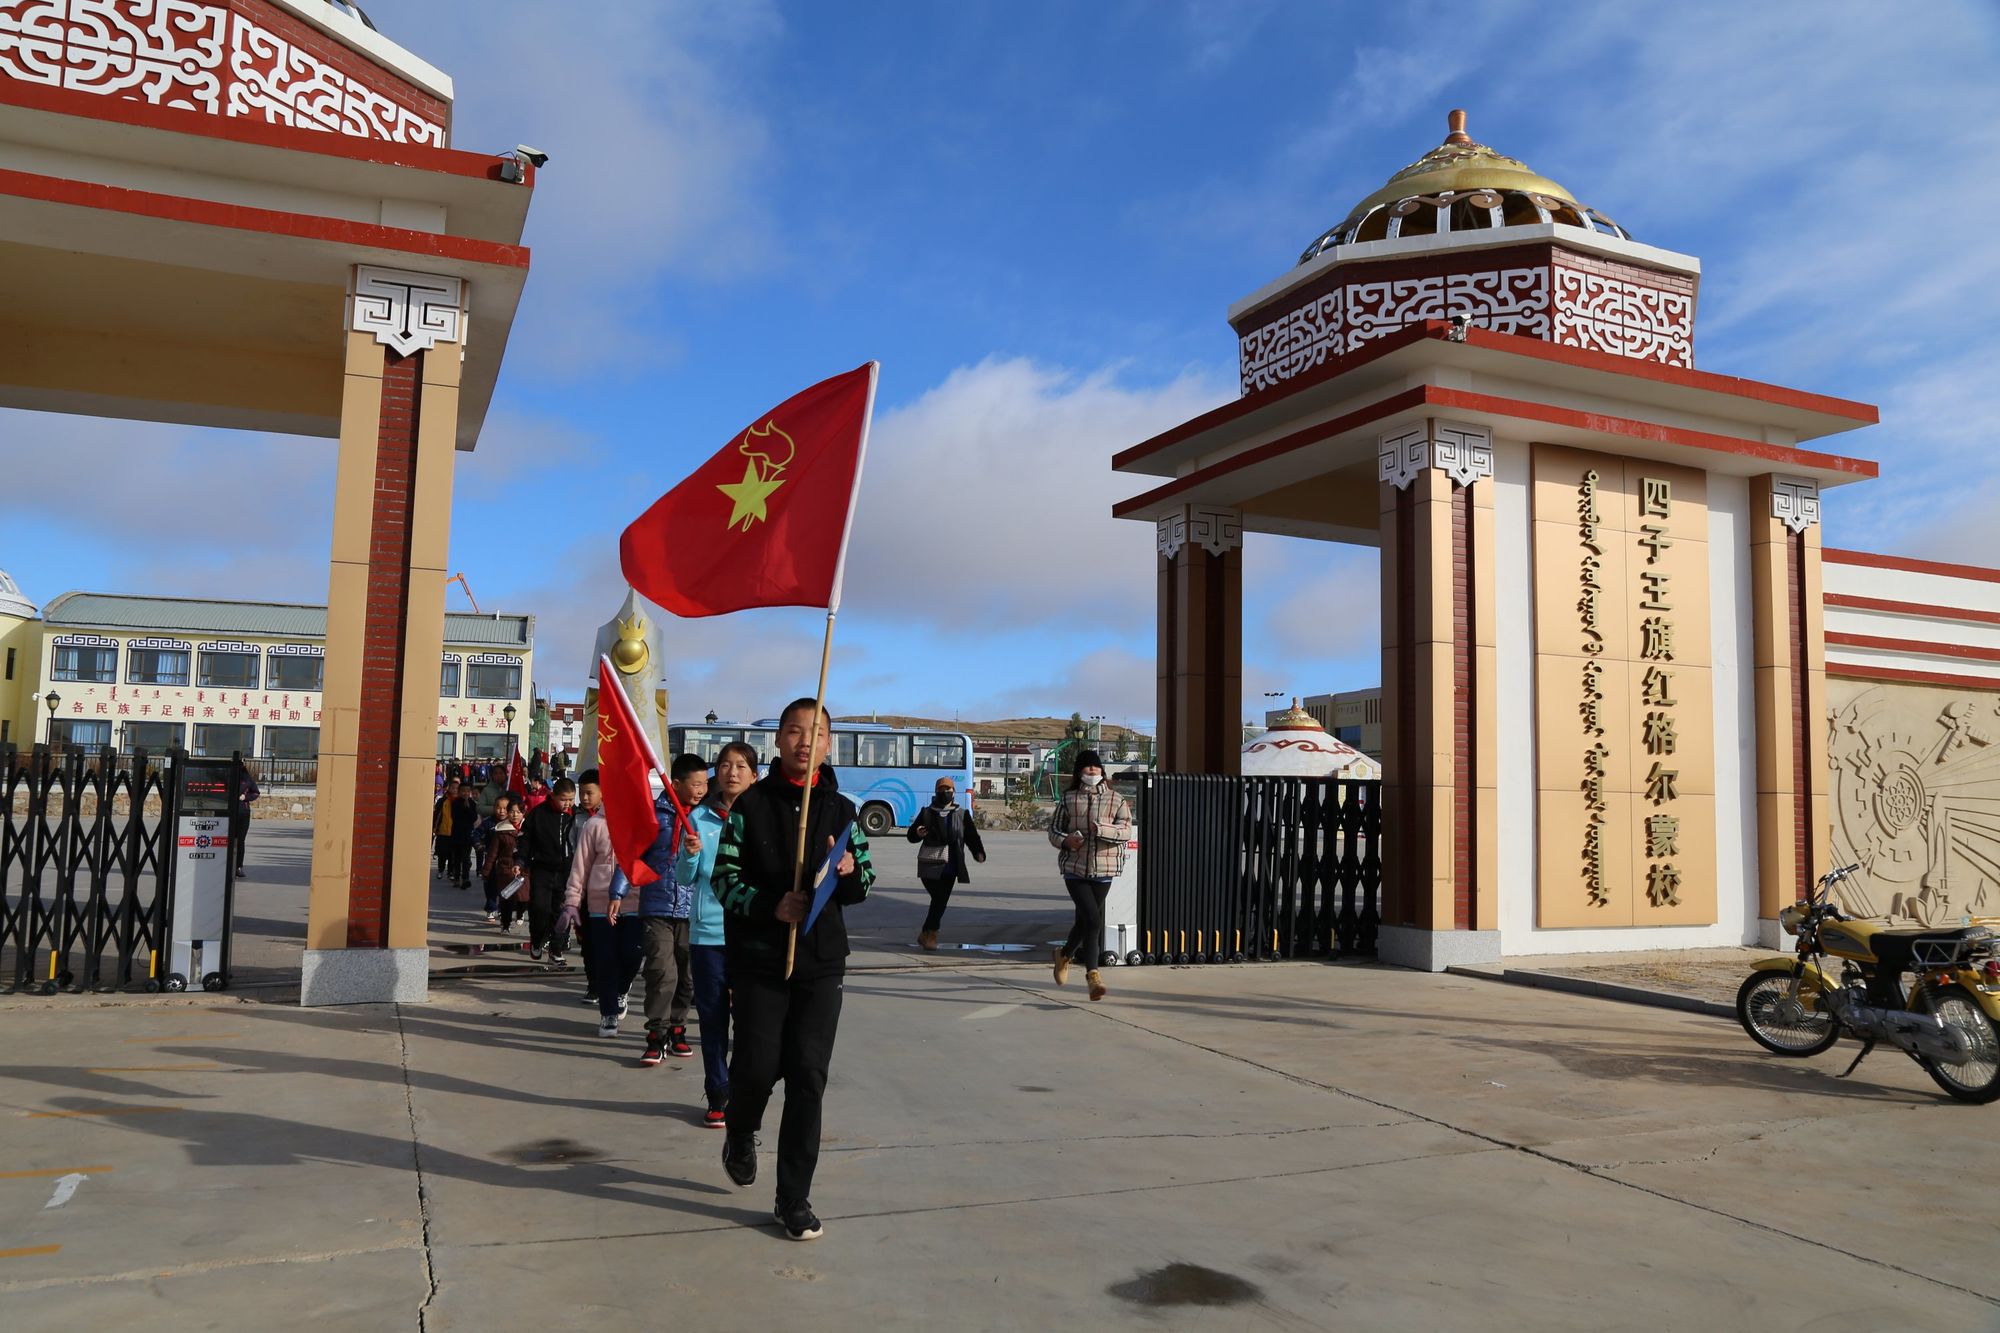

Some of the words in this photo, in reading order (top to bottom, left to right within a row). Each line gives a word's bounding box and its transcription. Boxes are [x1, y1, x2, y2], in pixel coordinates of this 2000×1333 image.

[438, 715, 507, 729] 美好生活
[1639, 476, 1682, 907] 四子王旗红格尔蒙校
